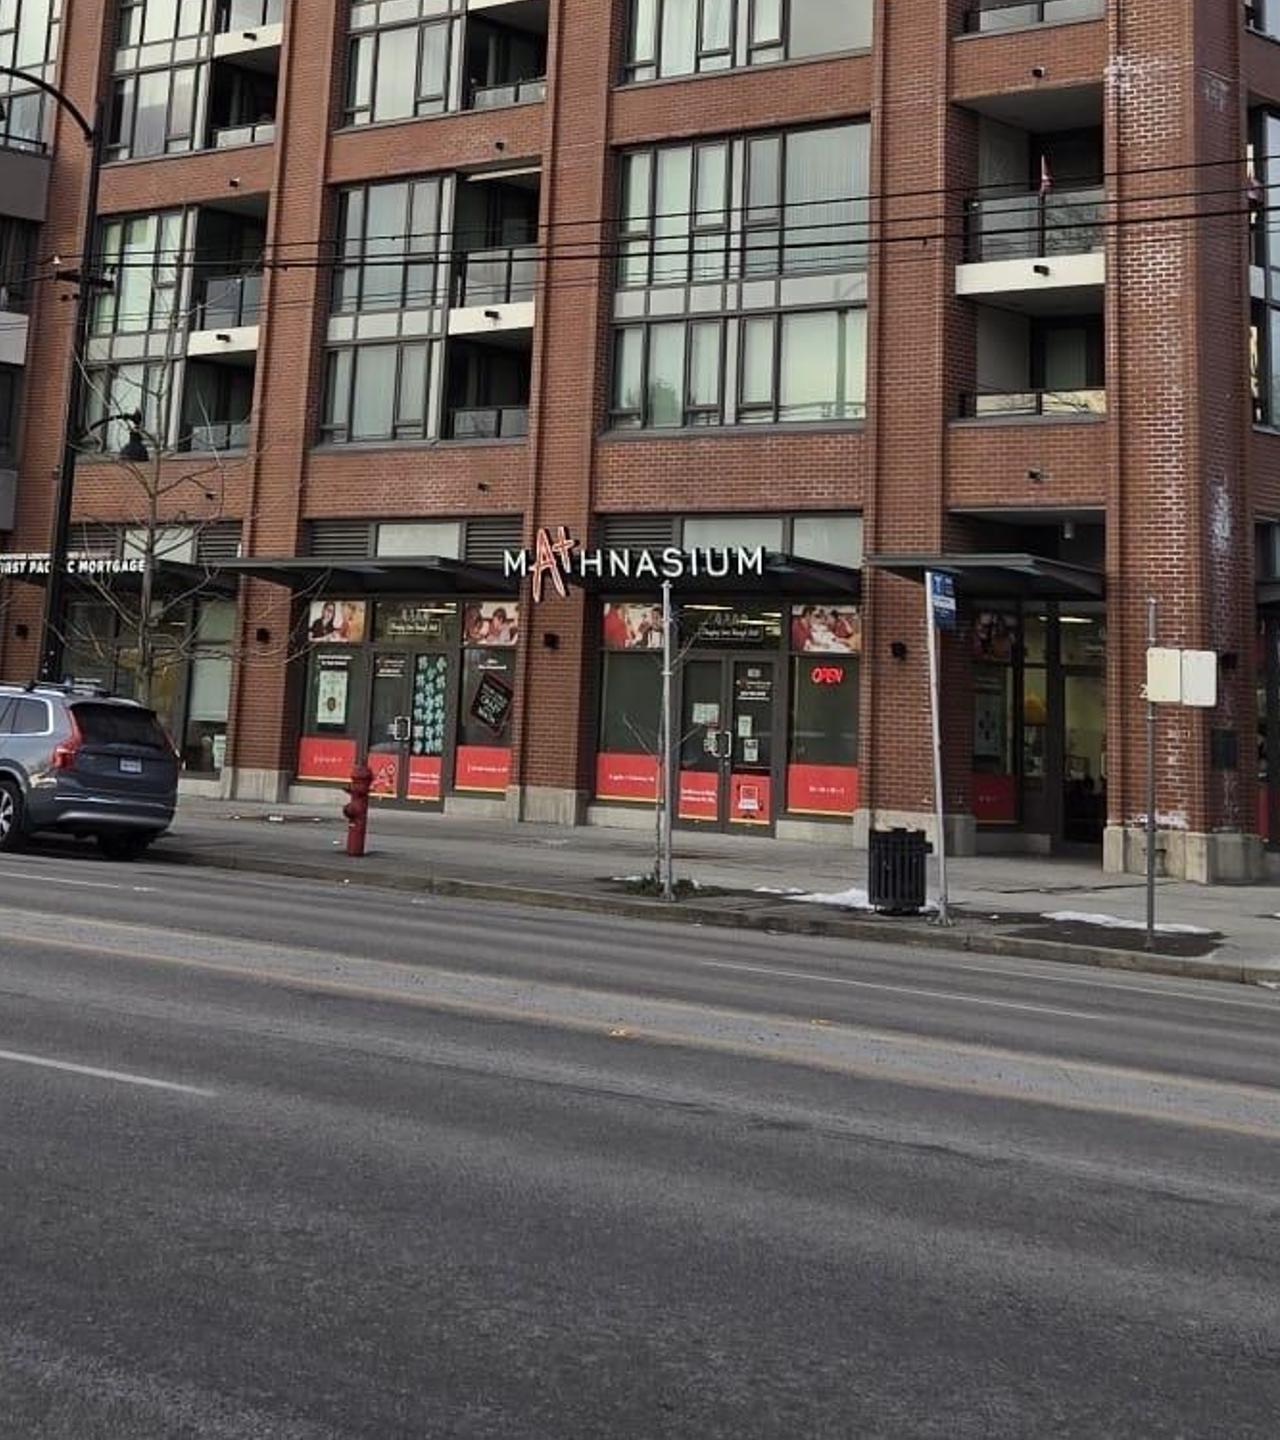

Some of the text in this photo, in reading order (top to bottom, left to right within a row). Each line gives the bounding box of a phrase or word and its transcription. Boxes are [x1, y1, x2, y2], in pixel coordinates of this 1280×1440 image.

[29, 560, 75, 574] PACC
[78, 558, 146, 574] MORTGAGE
[811, 667, 843, 684] OPEN
